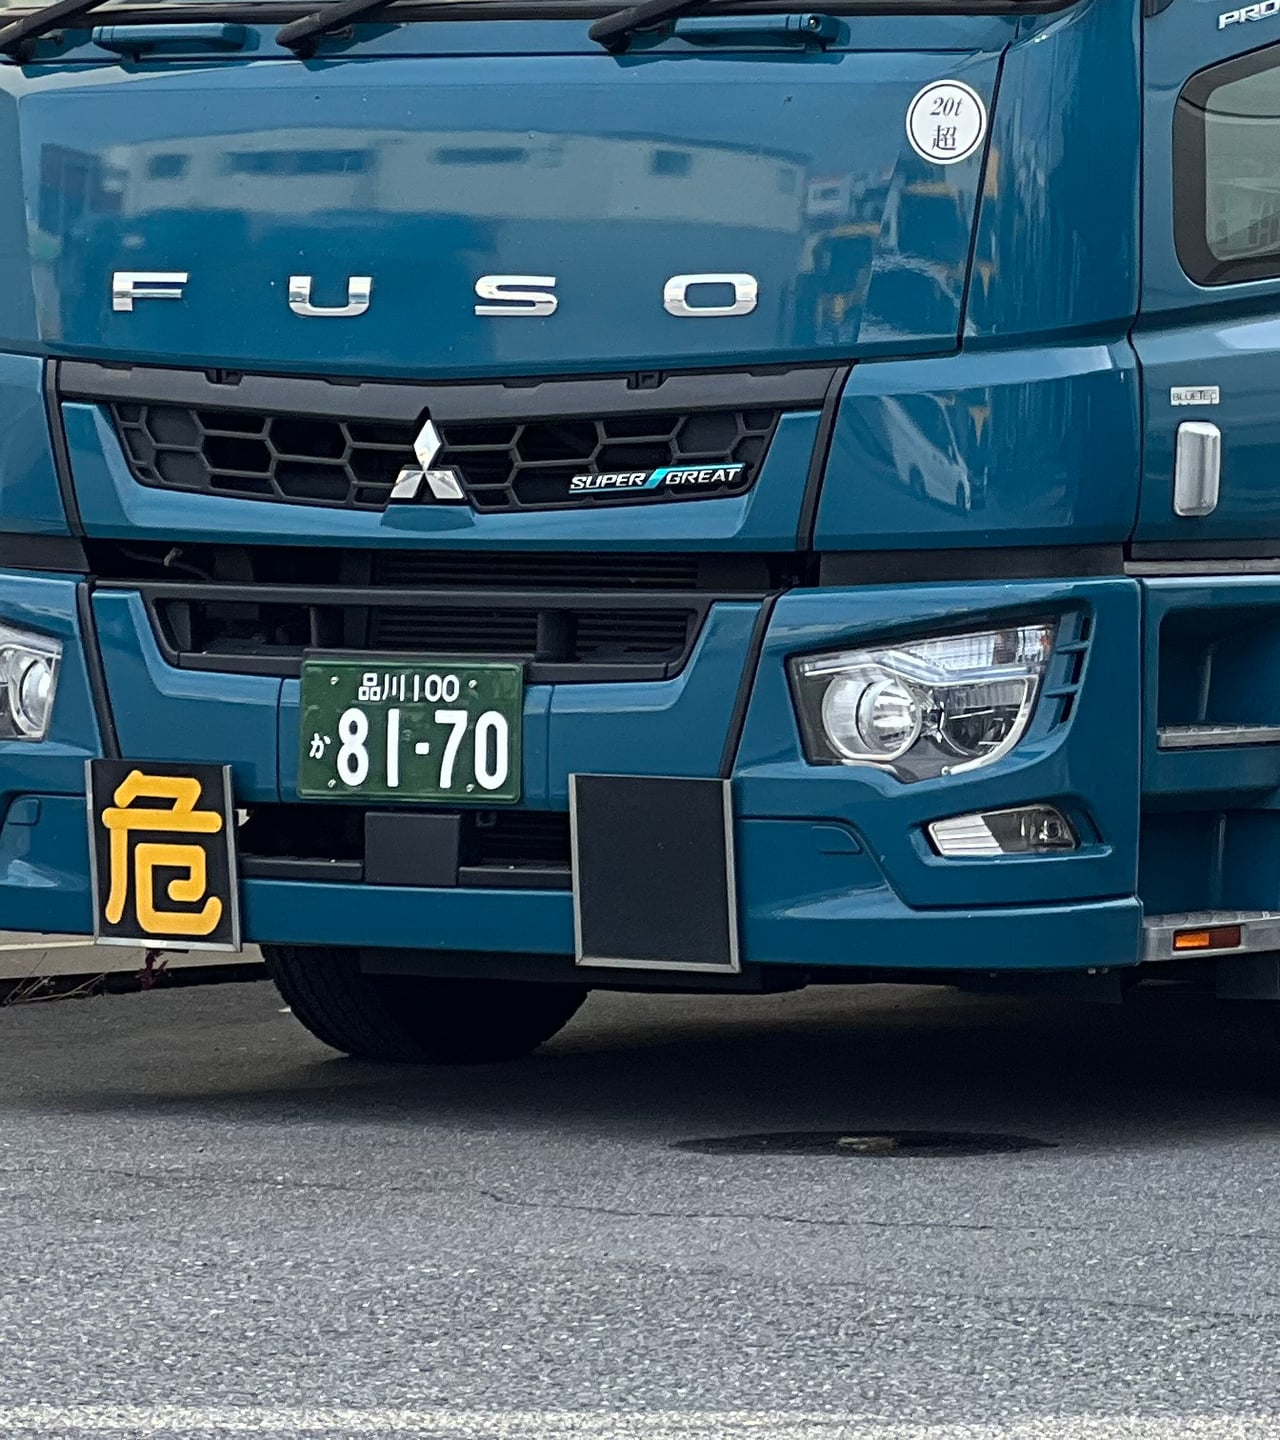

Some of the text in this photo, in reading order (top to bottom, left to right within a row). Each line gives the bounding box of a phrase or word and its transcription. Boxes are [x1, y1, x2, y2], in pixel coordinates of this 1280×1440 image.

[931, 124, 957, 151] 超
[112, 271, 759, 318] FUSO
[570, 468, 741, 490] SUPER GREAT
[358, 672, 460, 703] 品川 100
[309, 707, 509, 791] か 81-70
[101, 769, 223, 936] 危
